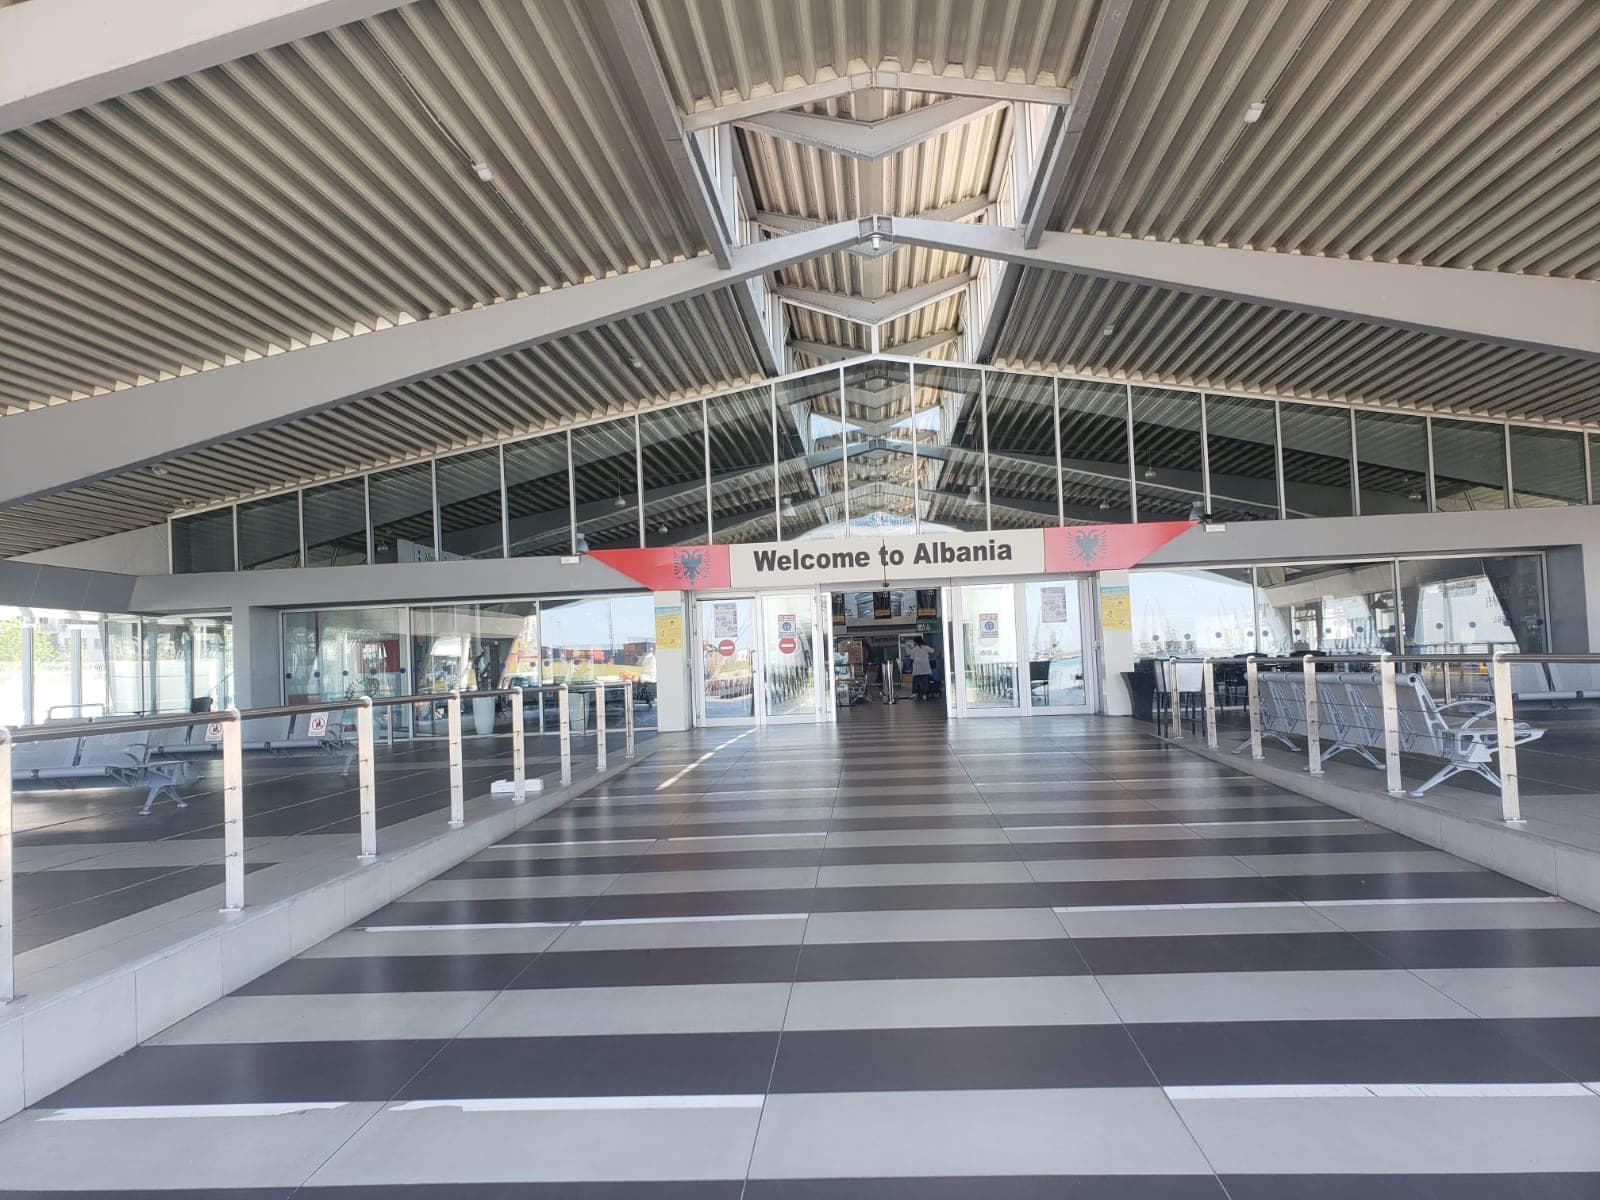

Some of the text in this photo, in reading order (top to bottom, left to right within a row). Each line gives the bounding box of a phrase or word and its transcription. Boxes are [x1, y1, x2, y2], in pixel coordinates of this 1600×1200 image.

[754, 540, 1012, 572] Welcome to Albania
